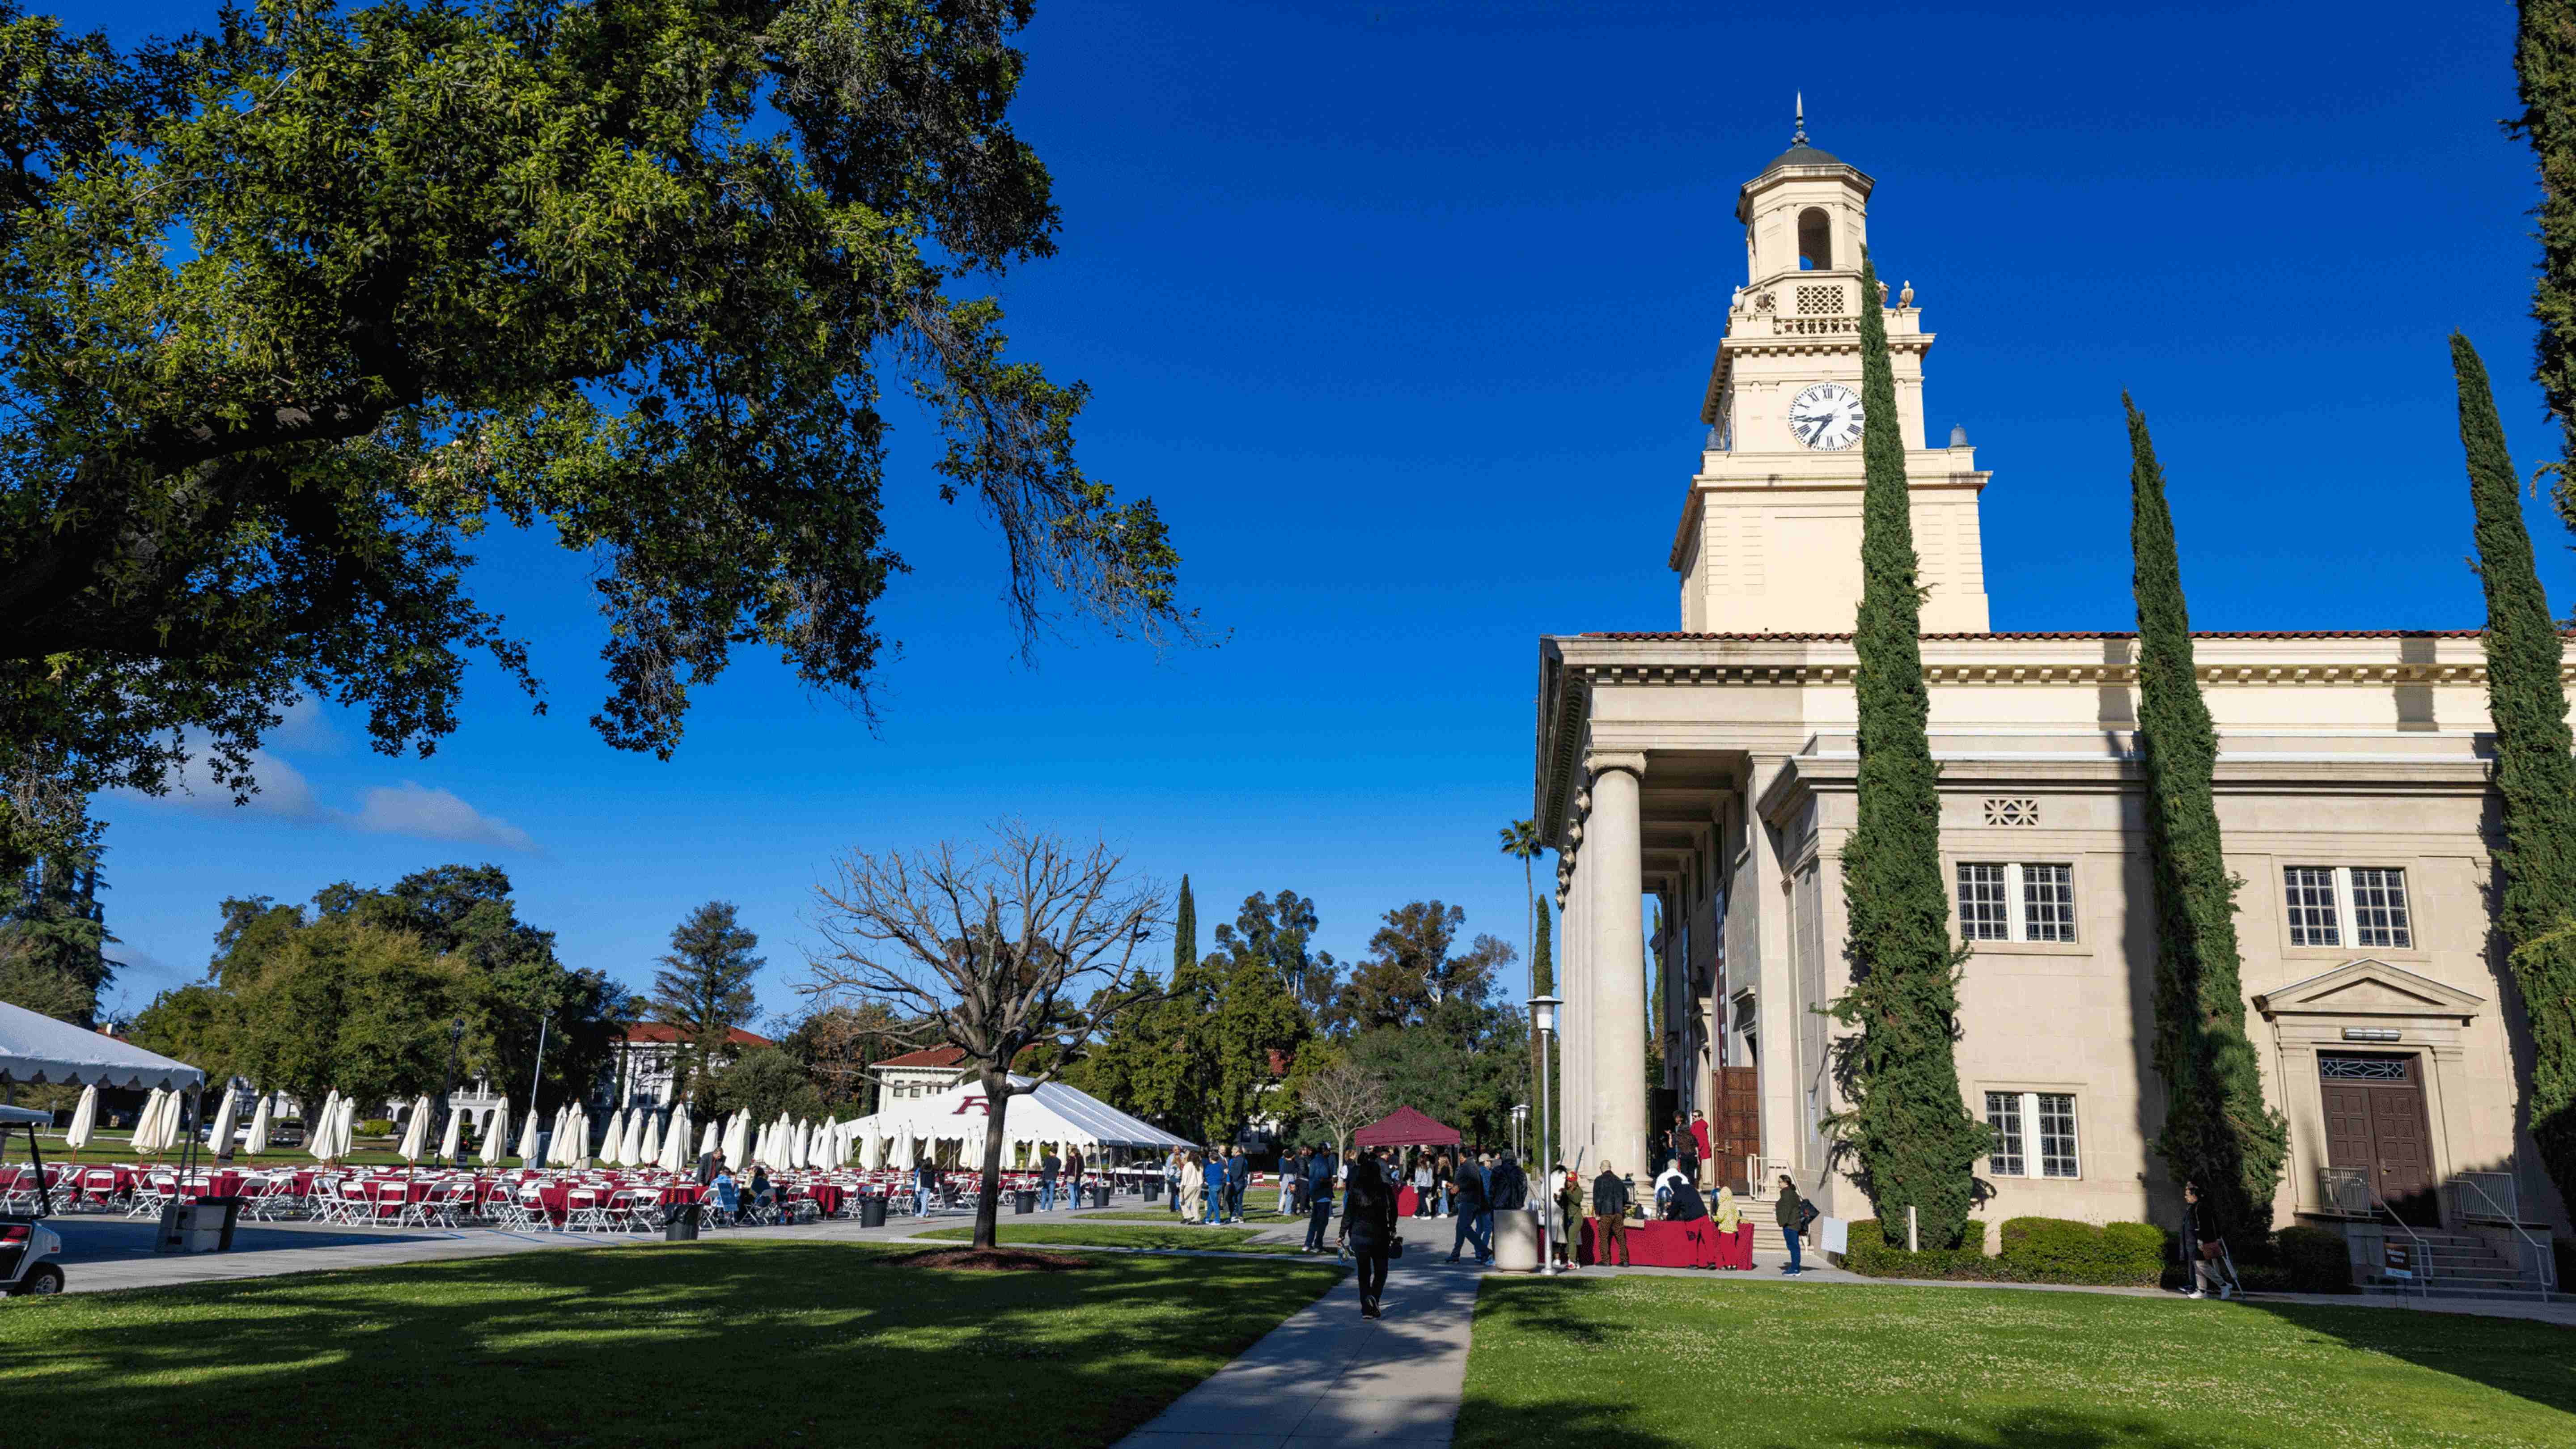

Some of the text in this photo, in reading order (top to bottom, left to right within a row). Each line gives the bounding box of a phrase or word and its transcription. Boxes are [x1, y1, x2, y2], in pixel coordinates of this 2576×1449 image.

[1822, 388, 1833, 399] XII
[1839, 391, 1846, 401] I
[1847, 401, 1860, 409] II
